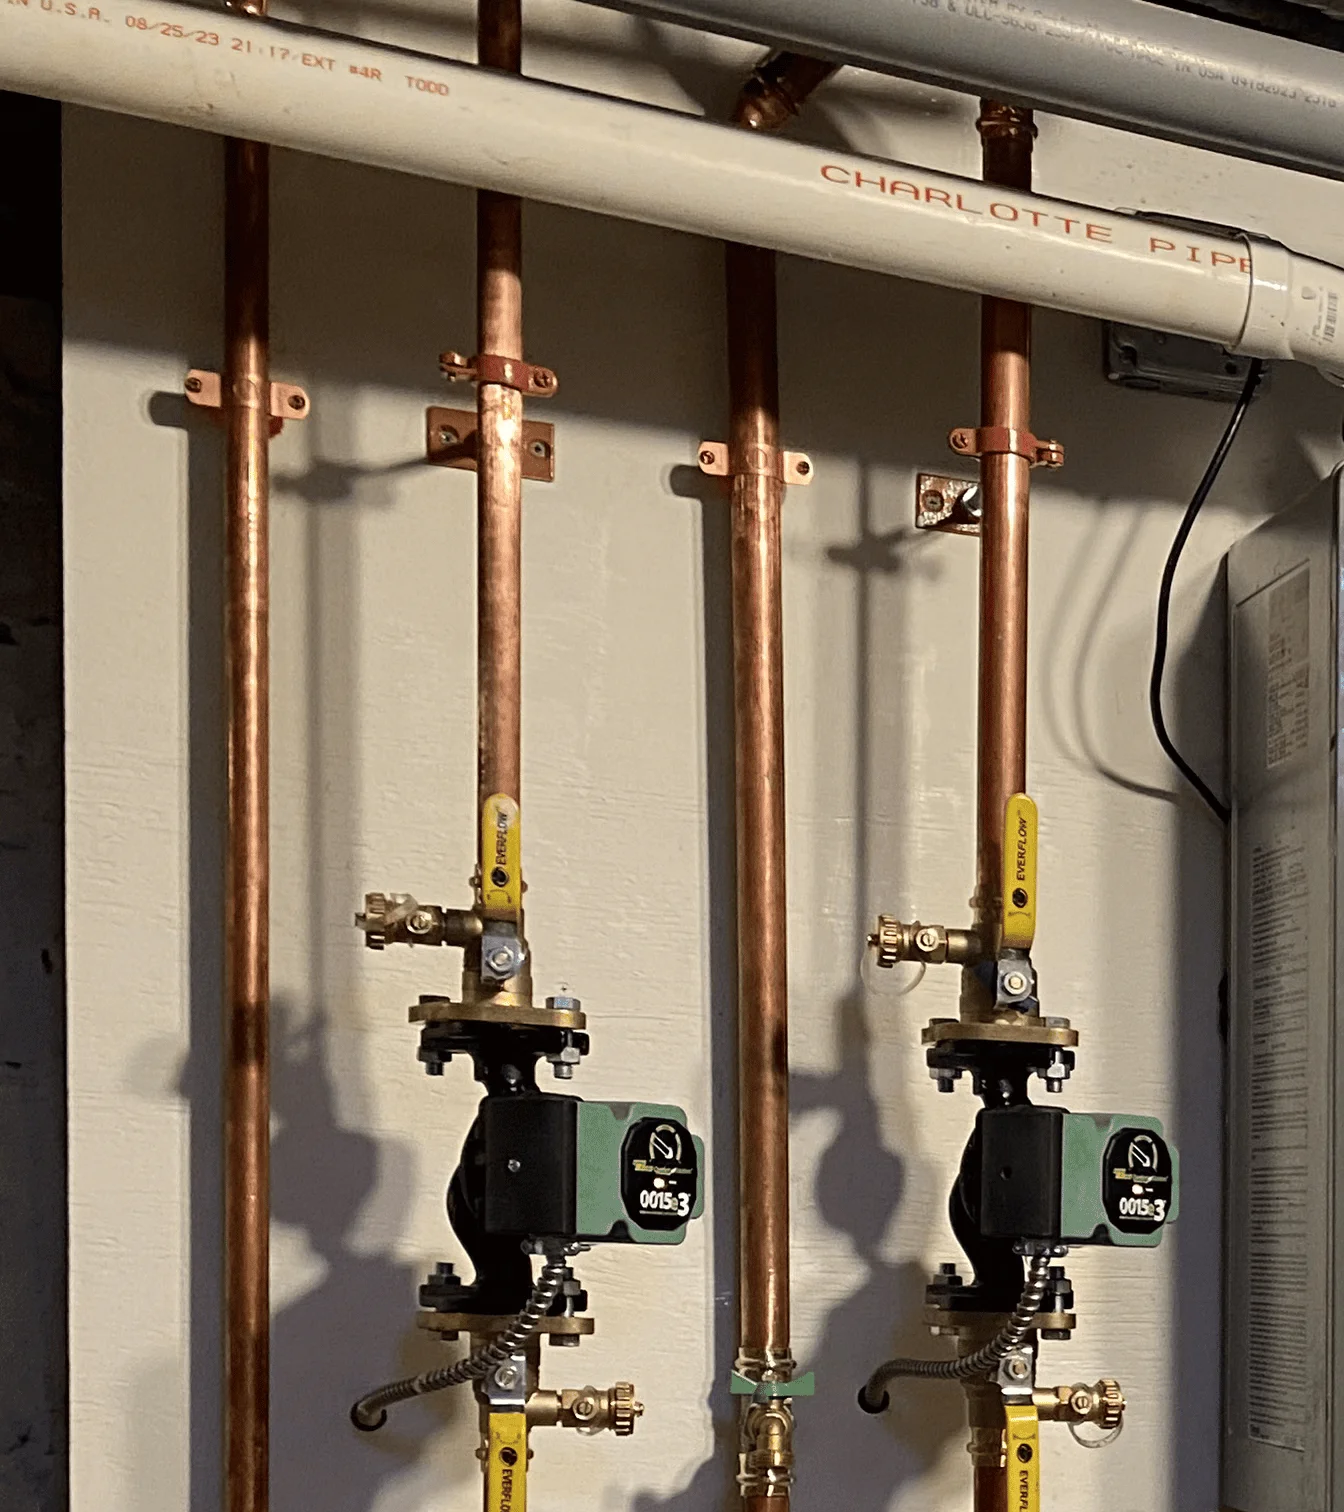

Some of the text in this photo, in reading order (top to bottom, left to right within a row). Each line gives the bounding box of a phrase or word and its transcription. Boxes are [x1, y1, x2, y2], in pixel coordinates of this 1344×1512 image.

[125, 15, 219, 46] 08/25/23
[819, 164, 1252, 275] CHARLOTTE PIPE
[1016, 817, 1027, 881] EVERFLOW
